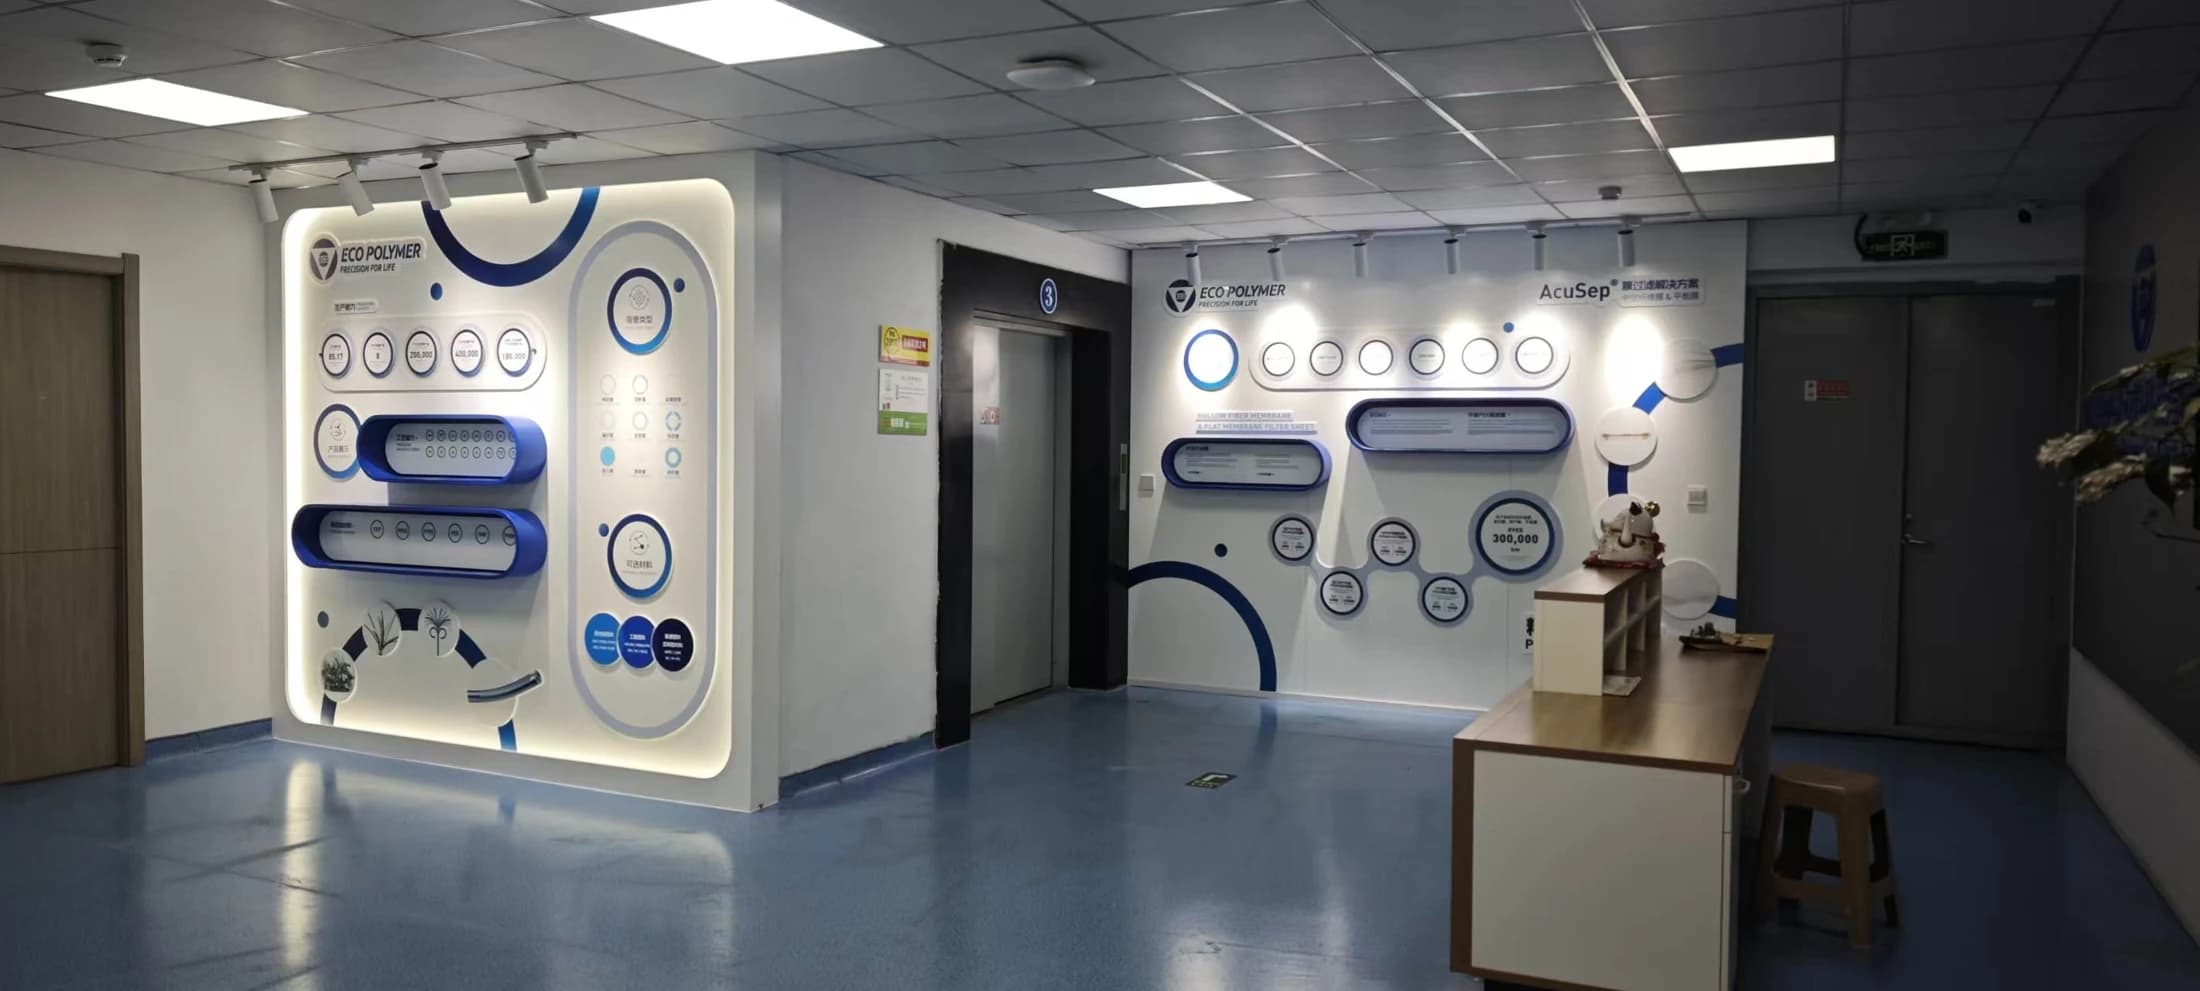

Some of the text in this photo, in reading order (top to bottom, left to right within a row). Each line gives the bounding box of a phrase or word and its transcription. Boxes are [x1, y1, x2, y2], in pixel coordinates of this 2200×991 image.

[341, 243, 422, 262] ECO POLYMER
[340, 263, 395, 273] PRECISION FOR LIFE
[1622, 278, 1700, 290] 膜过滤解决方案
[1045, 286, 1053, 307] 3
[1200, 284, 1286, 299] ECO POLYMER
[1244, 299, 1258, 307] LIFE
[1290, 423, 1315, 431] SHEET
[1492, 533, 1539, 545] 300,000
